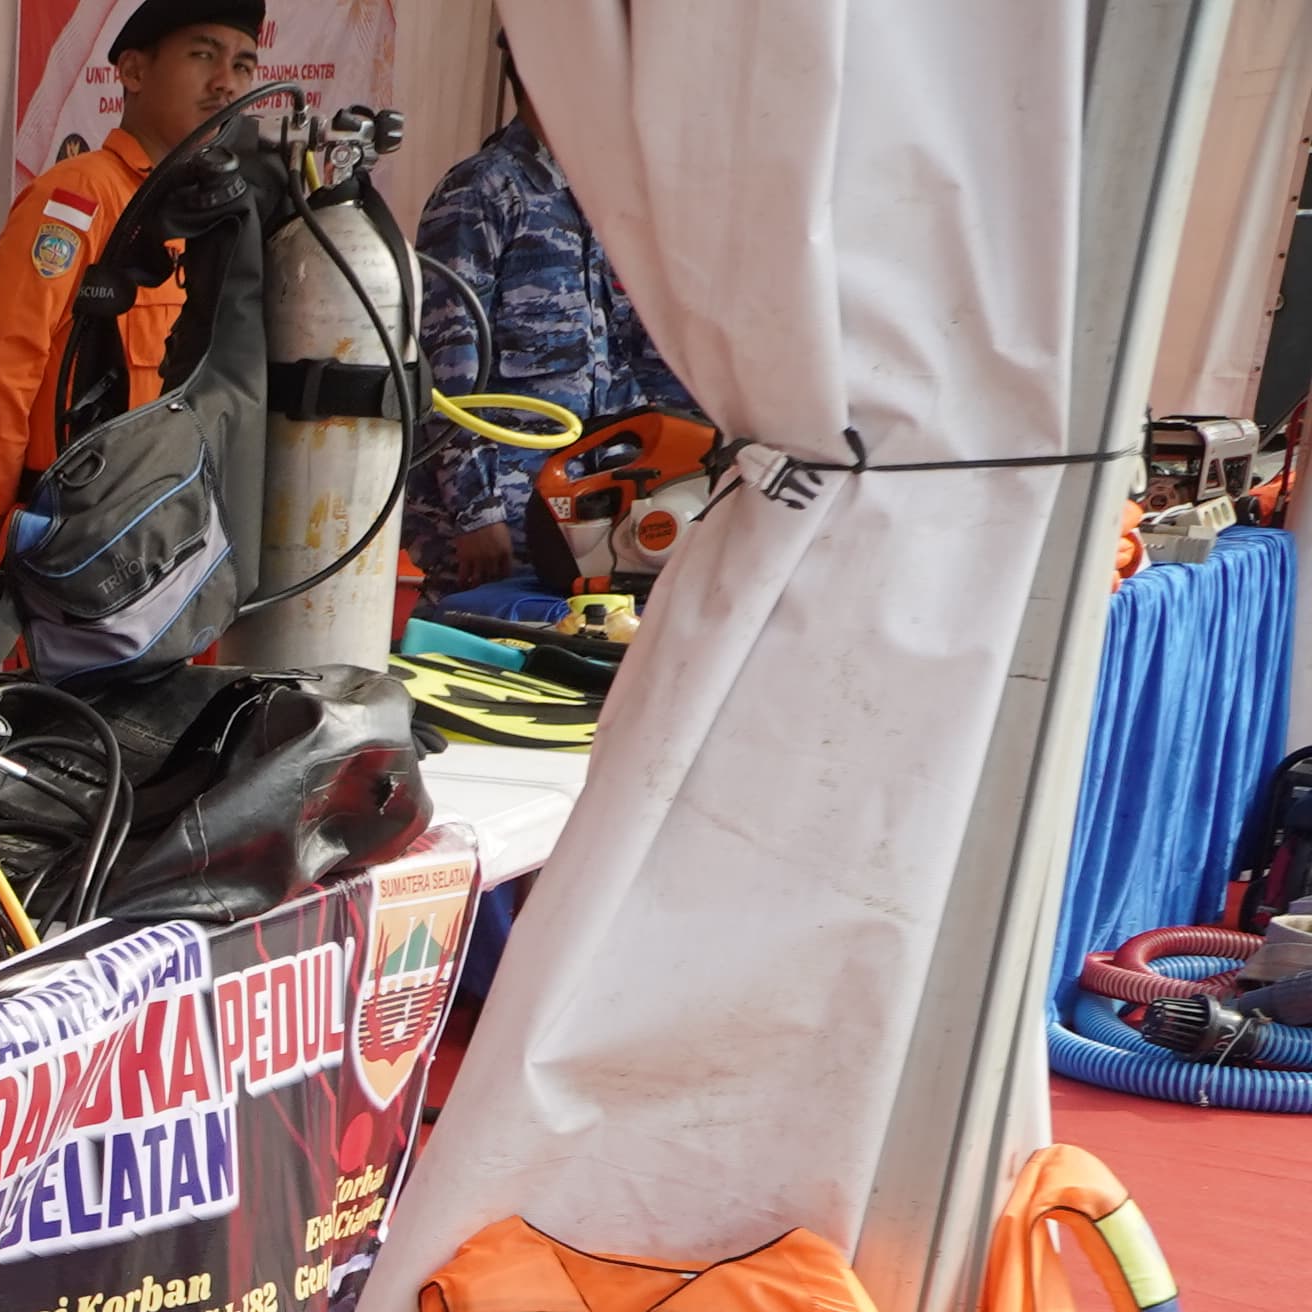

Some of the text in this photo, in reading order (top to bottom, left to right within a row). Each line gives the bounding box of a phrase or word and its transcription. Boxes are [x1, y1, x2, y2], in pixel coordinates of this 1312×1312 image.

[301, 62, 336, 79] CENTER
[380, 863, 471, 898] SUMATERA SELATAN
[215, 949, 345, 1094] PEDUL
